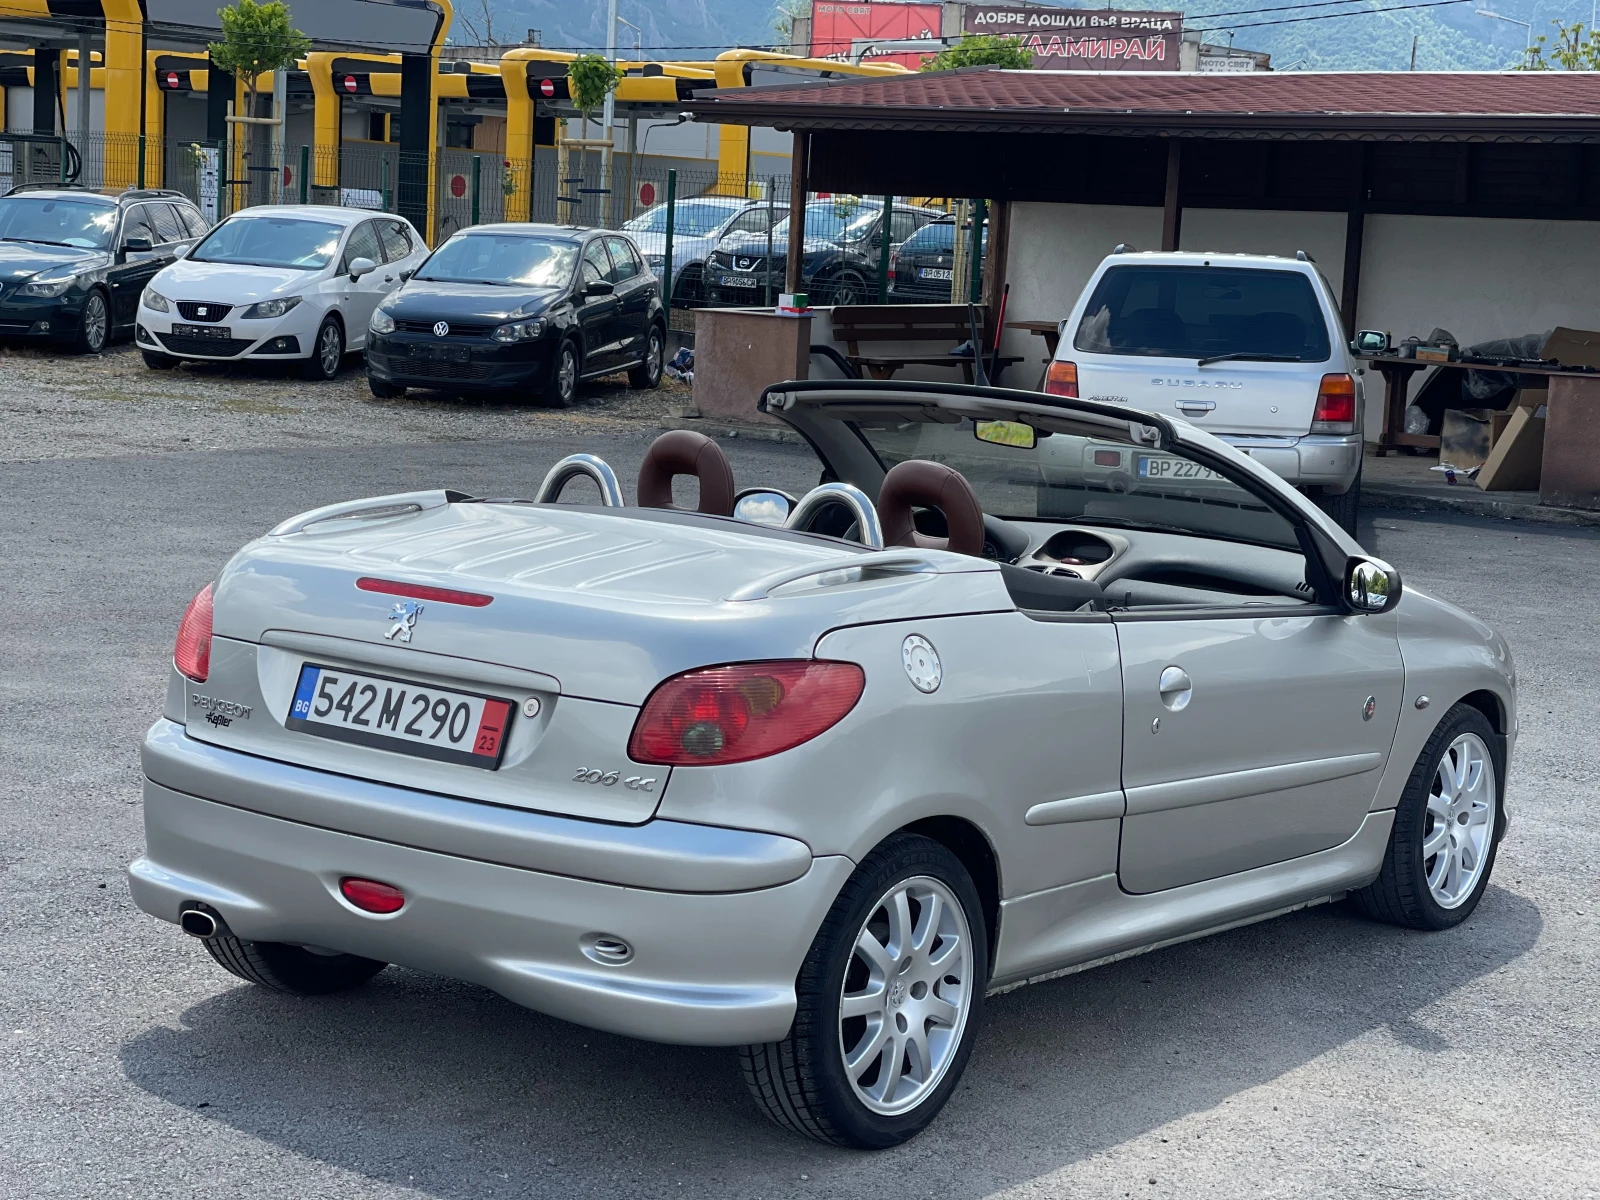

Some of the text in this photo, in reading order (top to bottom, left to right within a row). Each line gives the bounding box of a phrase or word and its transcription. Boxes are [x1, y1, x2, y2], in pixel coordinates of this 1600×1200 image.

[975, 12, 1025, 25] ДОБРЕ
[1028, 14, 1086, 27] ДОШЛИ
[1121, 17, 1172, 31] ВРАЦА
[1201, 60, 1250, 69] МОТО СВЯТ
[1151, 378, 1243, 389] SUBARU
[192, 693, 253, 719] PEUGEOT
[294, 699, 310, 713] BG
[478, 735, 495, 751] 23
[571, 766, 620, 786] 206
